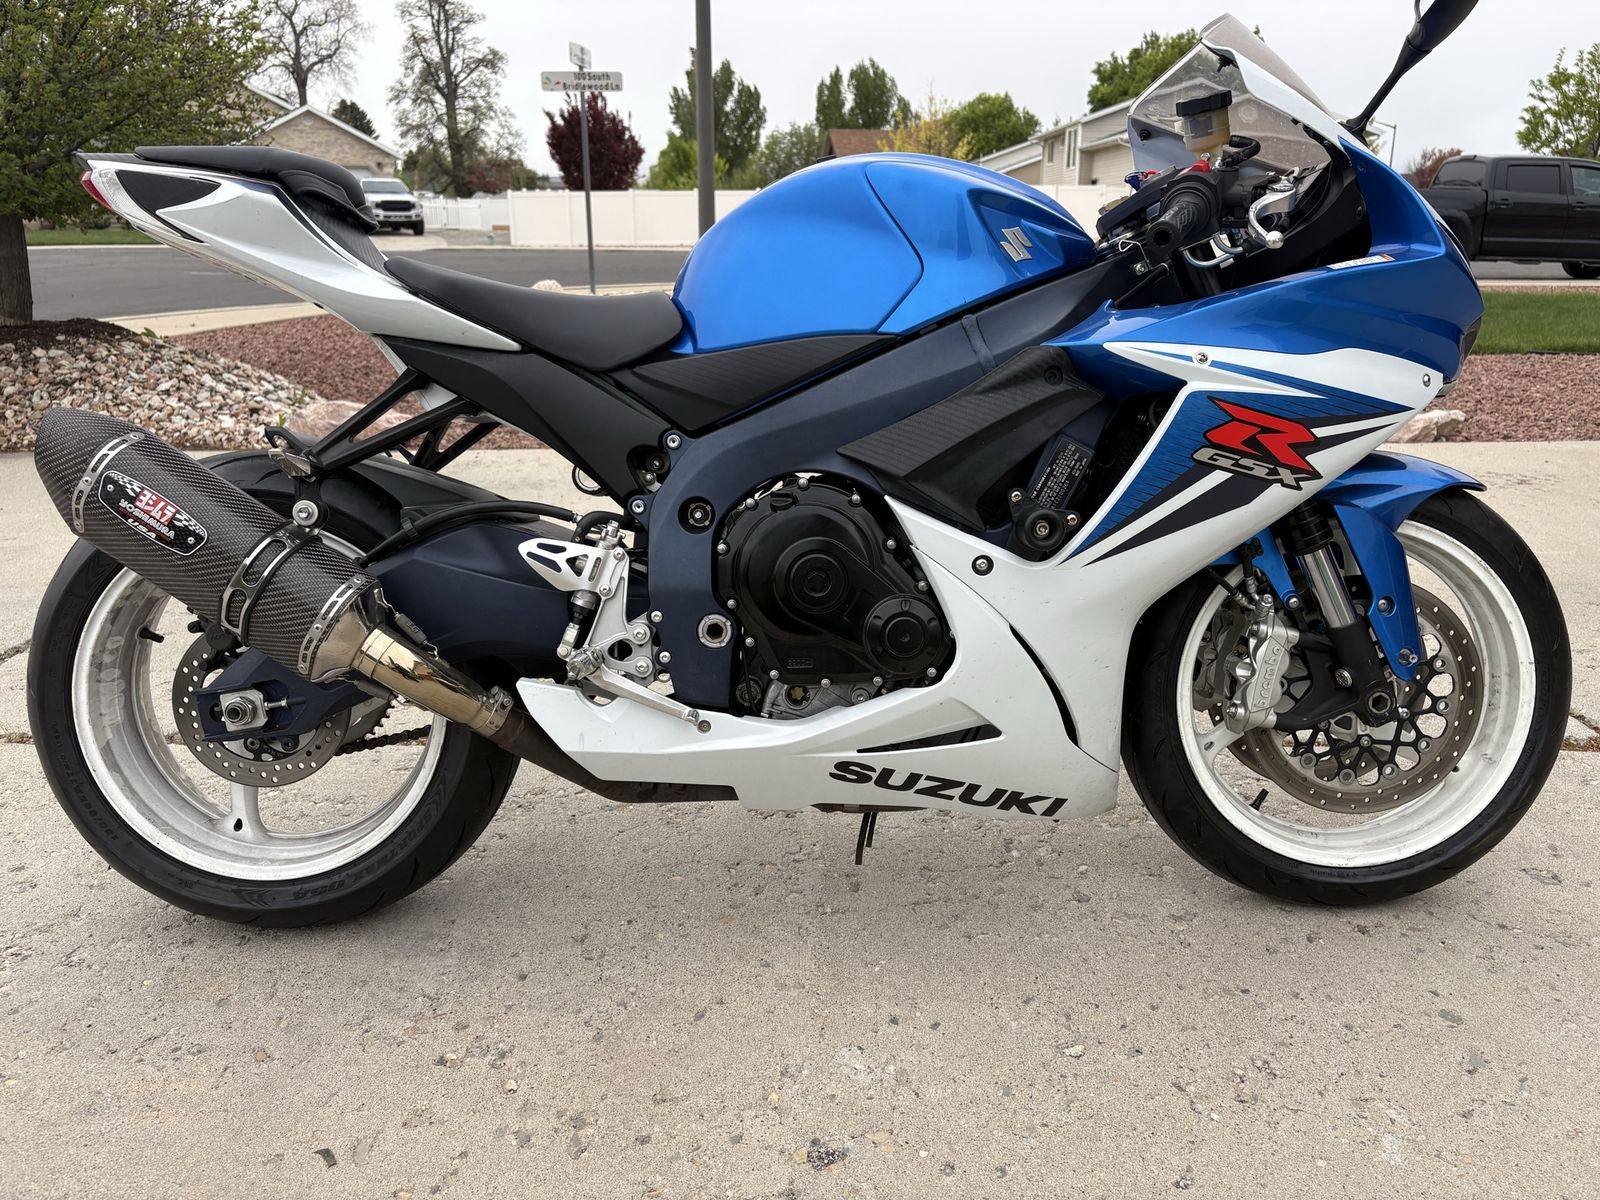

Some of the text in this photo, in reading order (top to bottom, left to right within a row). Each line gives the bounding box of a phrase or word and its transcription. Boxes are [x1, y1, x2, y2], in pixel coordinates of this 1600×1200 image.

[587, 72, 611, 81] South
[1192, 446, 1313, 487] GSX
[119, 498, 175, 540] YOSHIMURA
[127, 518, 157, 539] USA
[1253, 645, 1281, 708] brembo
[828, 760, 1069, 817] SUZUKI
